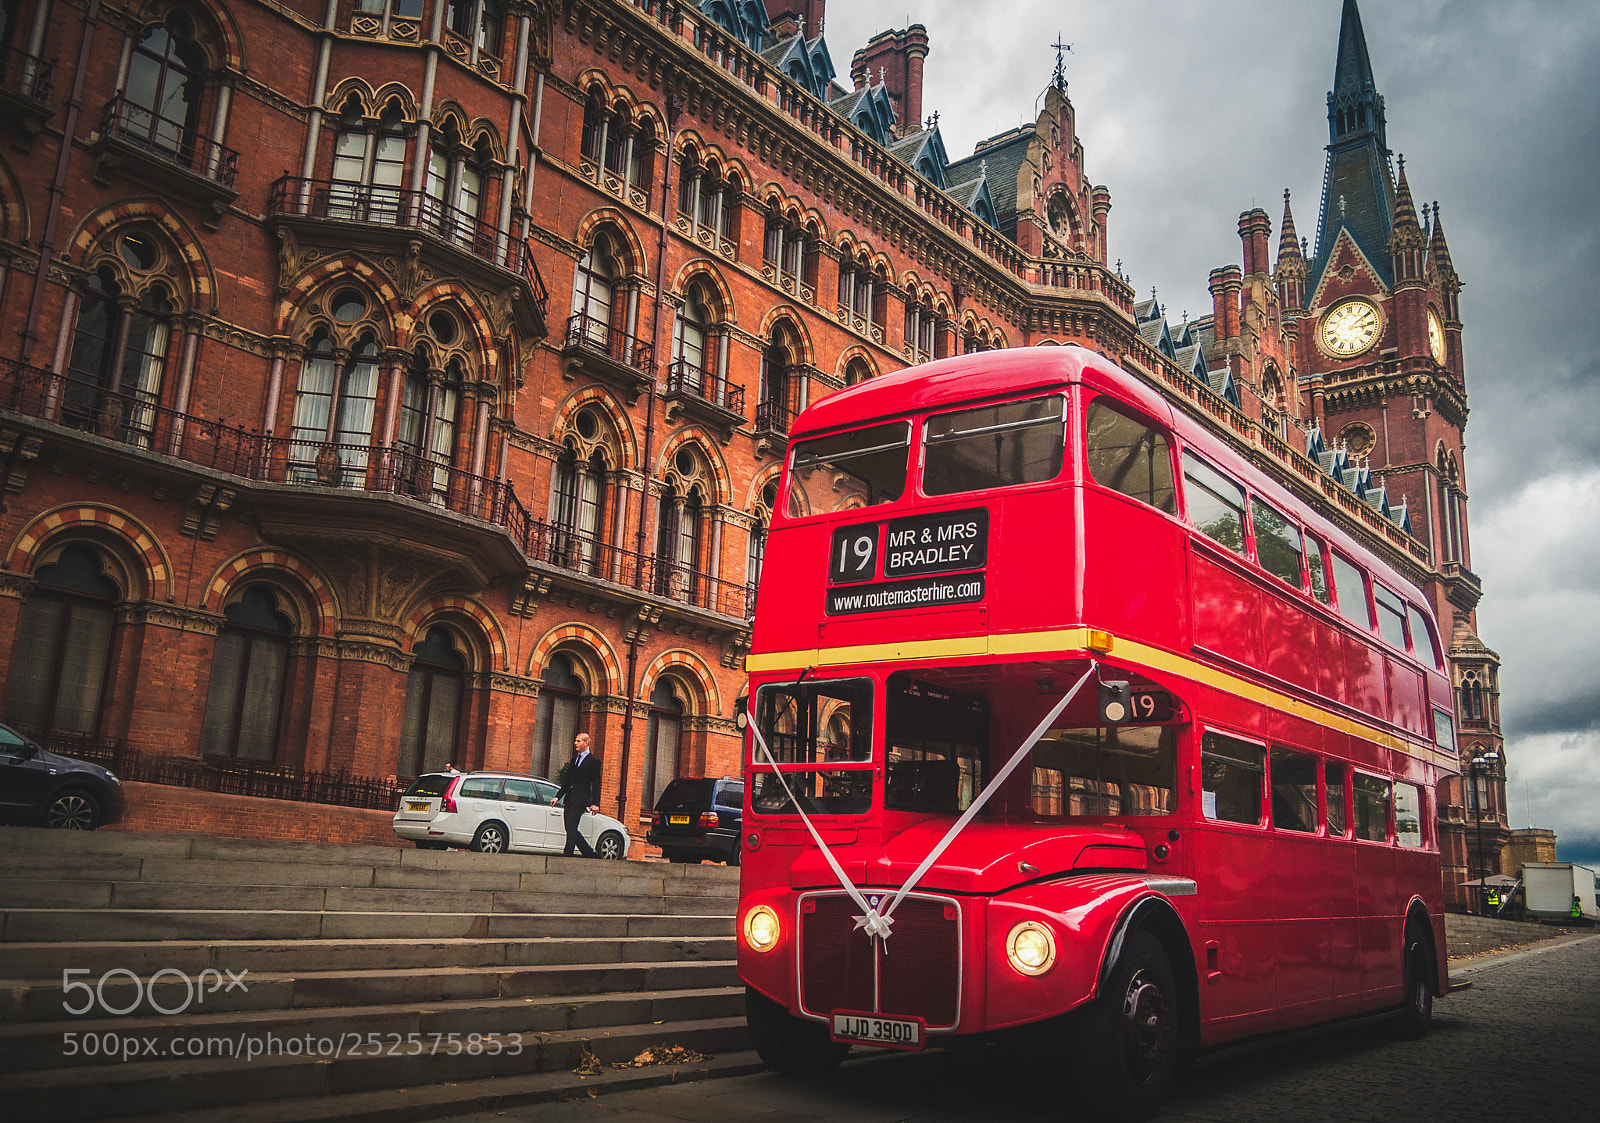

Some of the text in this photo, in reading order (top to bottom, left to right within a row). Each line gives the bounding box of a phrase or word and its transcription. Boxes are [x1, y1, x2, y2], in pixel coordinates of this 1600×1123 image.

[889, 522, 978, 548] MR & MRS
[839, 536, 873, 573] 19
[890, 543, 974, 568] BRADLEY
[834, 581, 981, 611] www.routemasterhire.com
[1130, 694, 1155, 718] 19
[841, 1018, 912, 1041] JJD 390D
